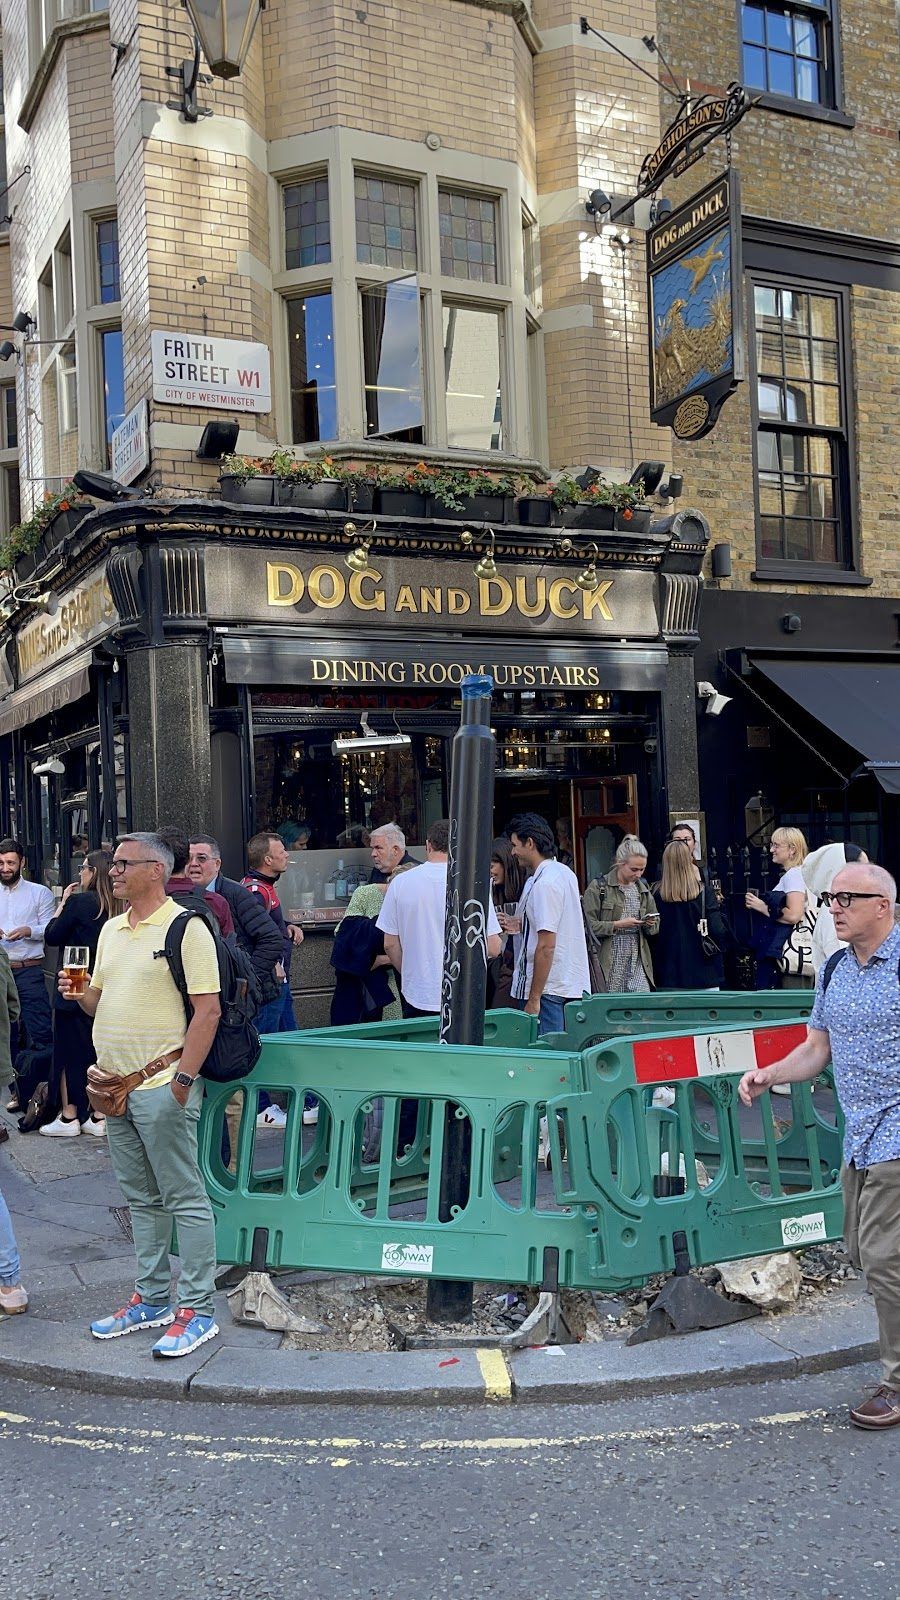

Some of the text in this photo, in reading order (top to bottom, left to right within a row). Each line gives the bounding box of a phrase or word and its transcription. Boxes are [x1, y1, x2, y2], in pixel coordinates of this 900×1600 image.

[650, 102, 725, 174] NICHOLSON'S
[654, 190, 724, 255] DOG AND DUCK
[164, 339, 214, 361] FRITH
[165, 361, 260, 389] STREET W1
[165, 389, 255, 407] CITY OF WESTMINSTER
[133, 432, 142, 453] W1
[267, 561, 614, 622] DOG AND DUCK
[311, 659, 600, 687] DINING ROOM UPSTAIRS
[784, 1220, 824, 1236] CONWAY
[384, 1250, 432, 1263] CONWAY
